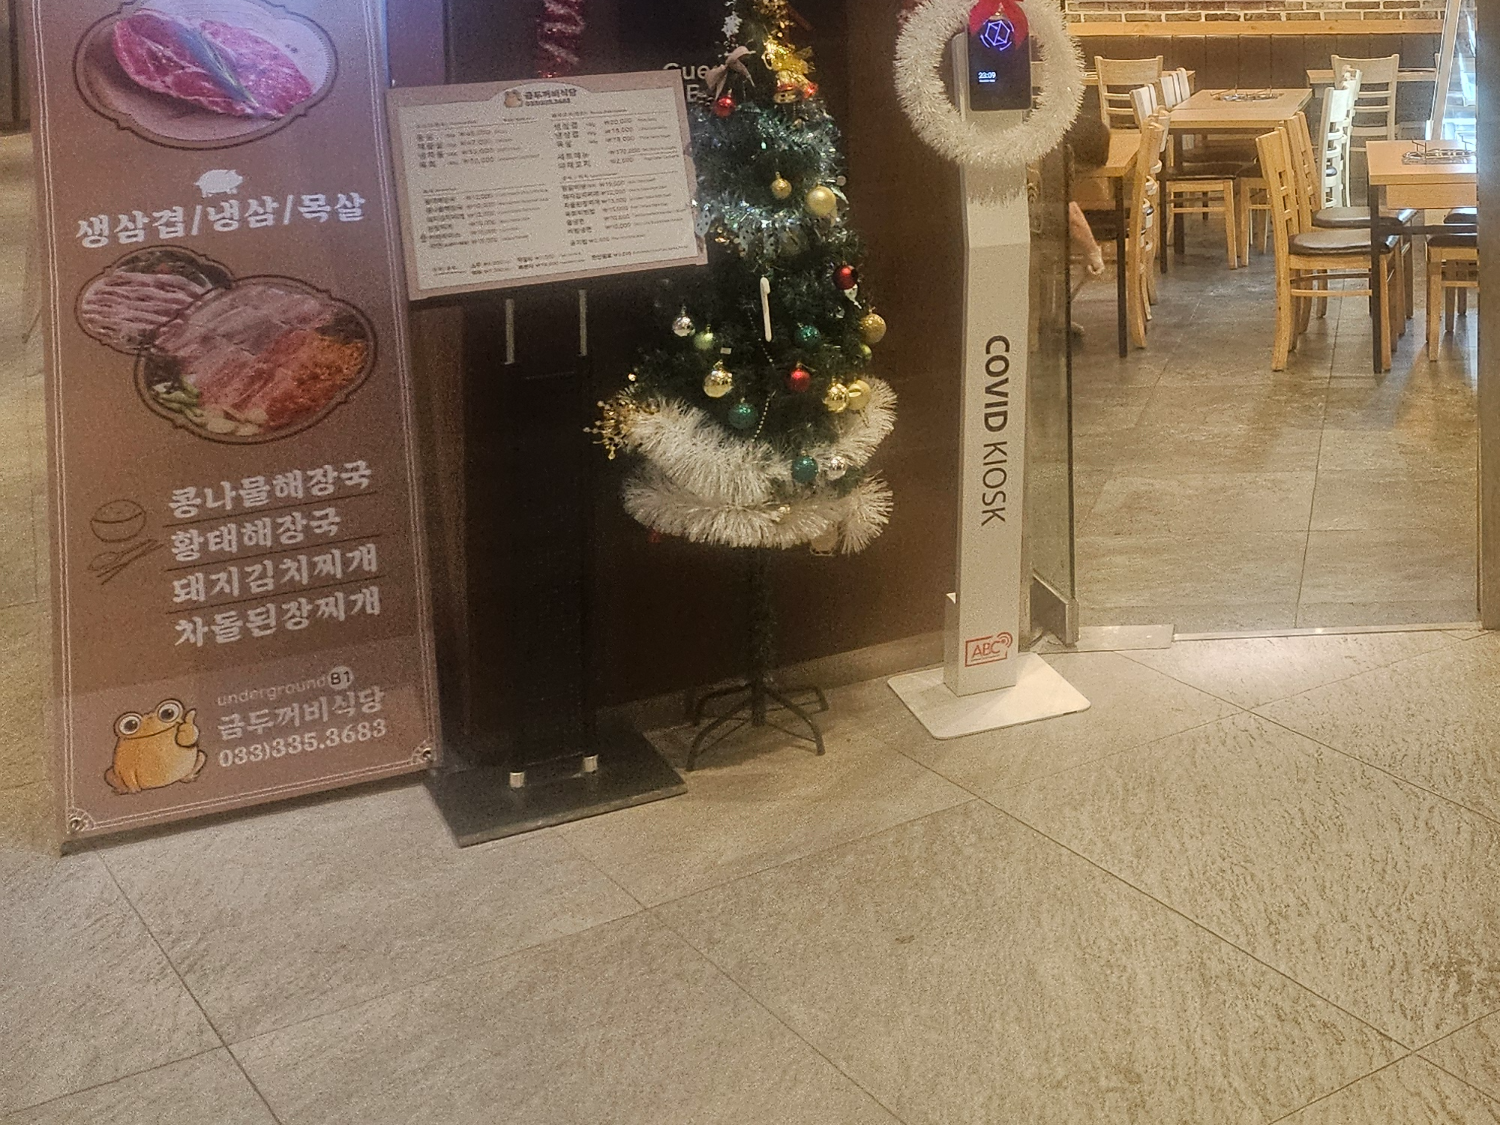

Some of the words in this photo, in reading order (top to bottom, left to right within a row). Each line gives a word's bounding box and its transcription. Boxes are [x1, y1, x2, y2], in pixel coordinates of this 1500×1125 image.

[985, 335, 1010, 432] COVID
[168, 459, 372, 519] 콩나물해장국
[981, 440, 1007, 526] KIOSK
[170, 507, 342, 562] 황태해장국
[172, 543, 378, 603] 돼지김치찌개
[174, 585, 381, 647] 차돌된장찌개
[971, 640, 1000, 658] ABC
[217, 676, 327, 707] underground
[217, 685, 385, 741] 금두꺼비식당
[218, 718, 387, 768] 033)335.3683
